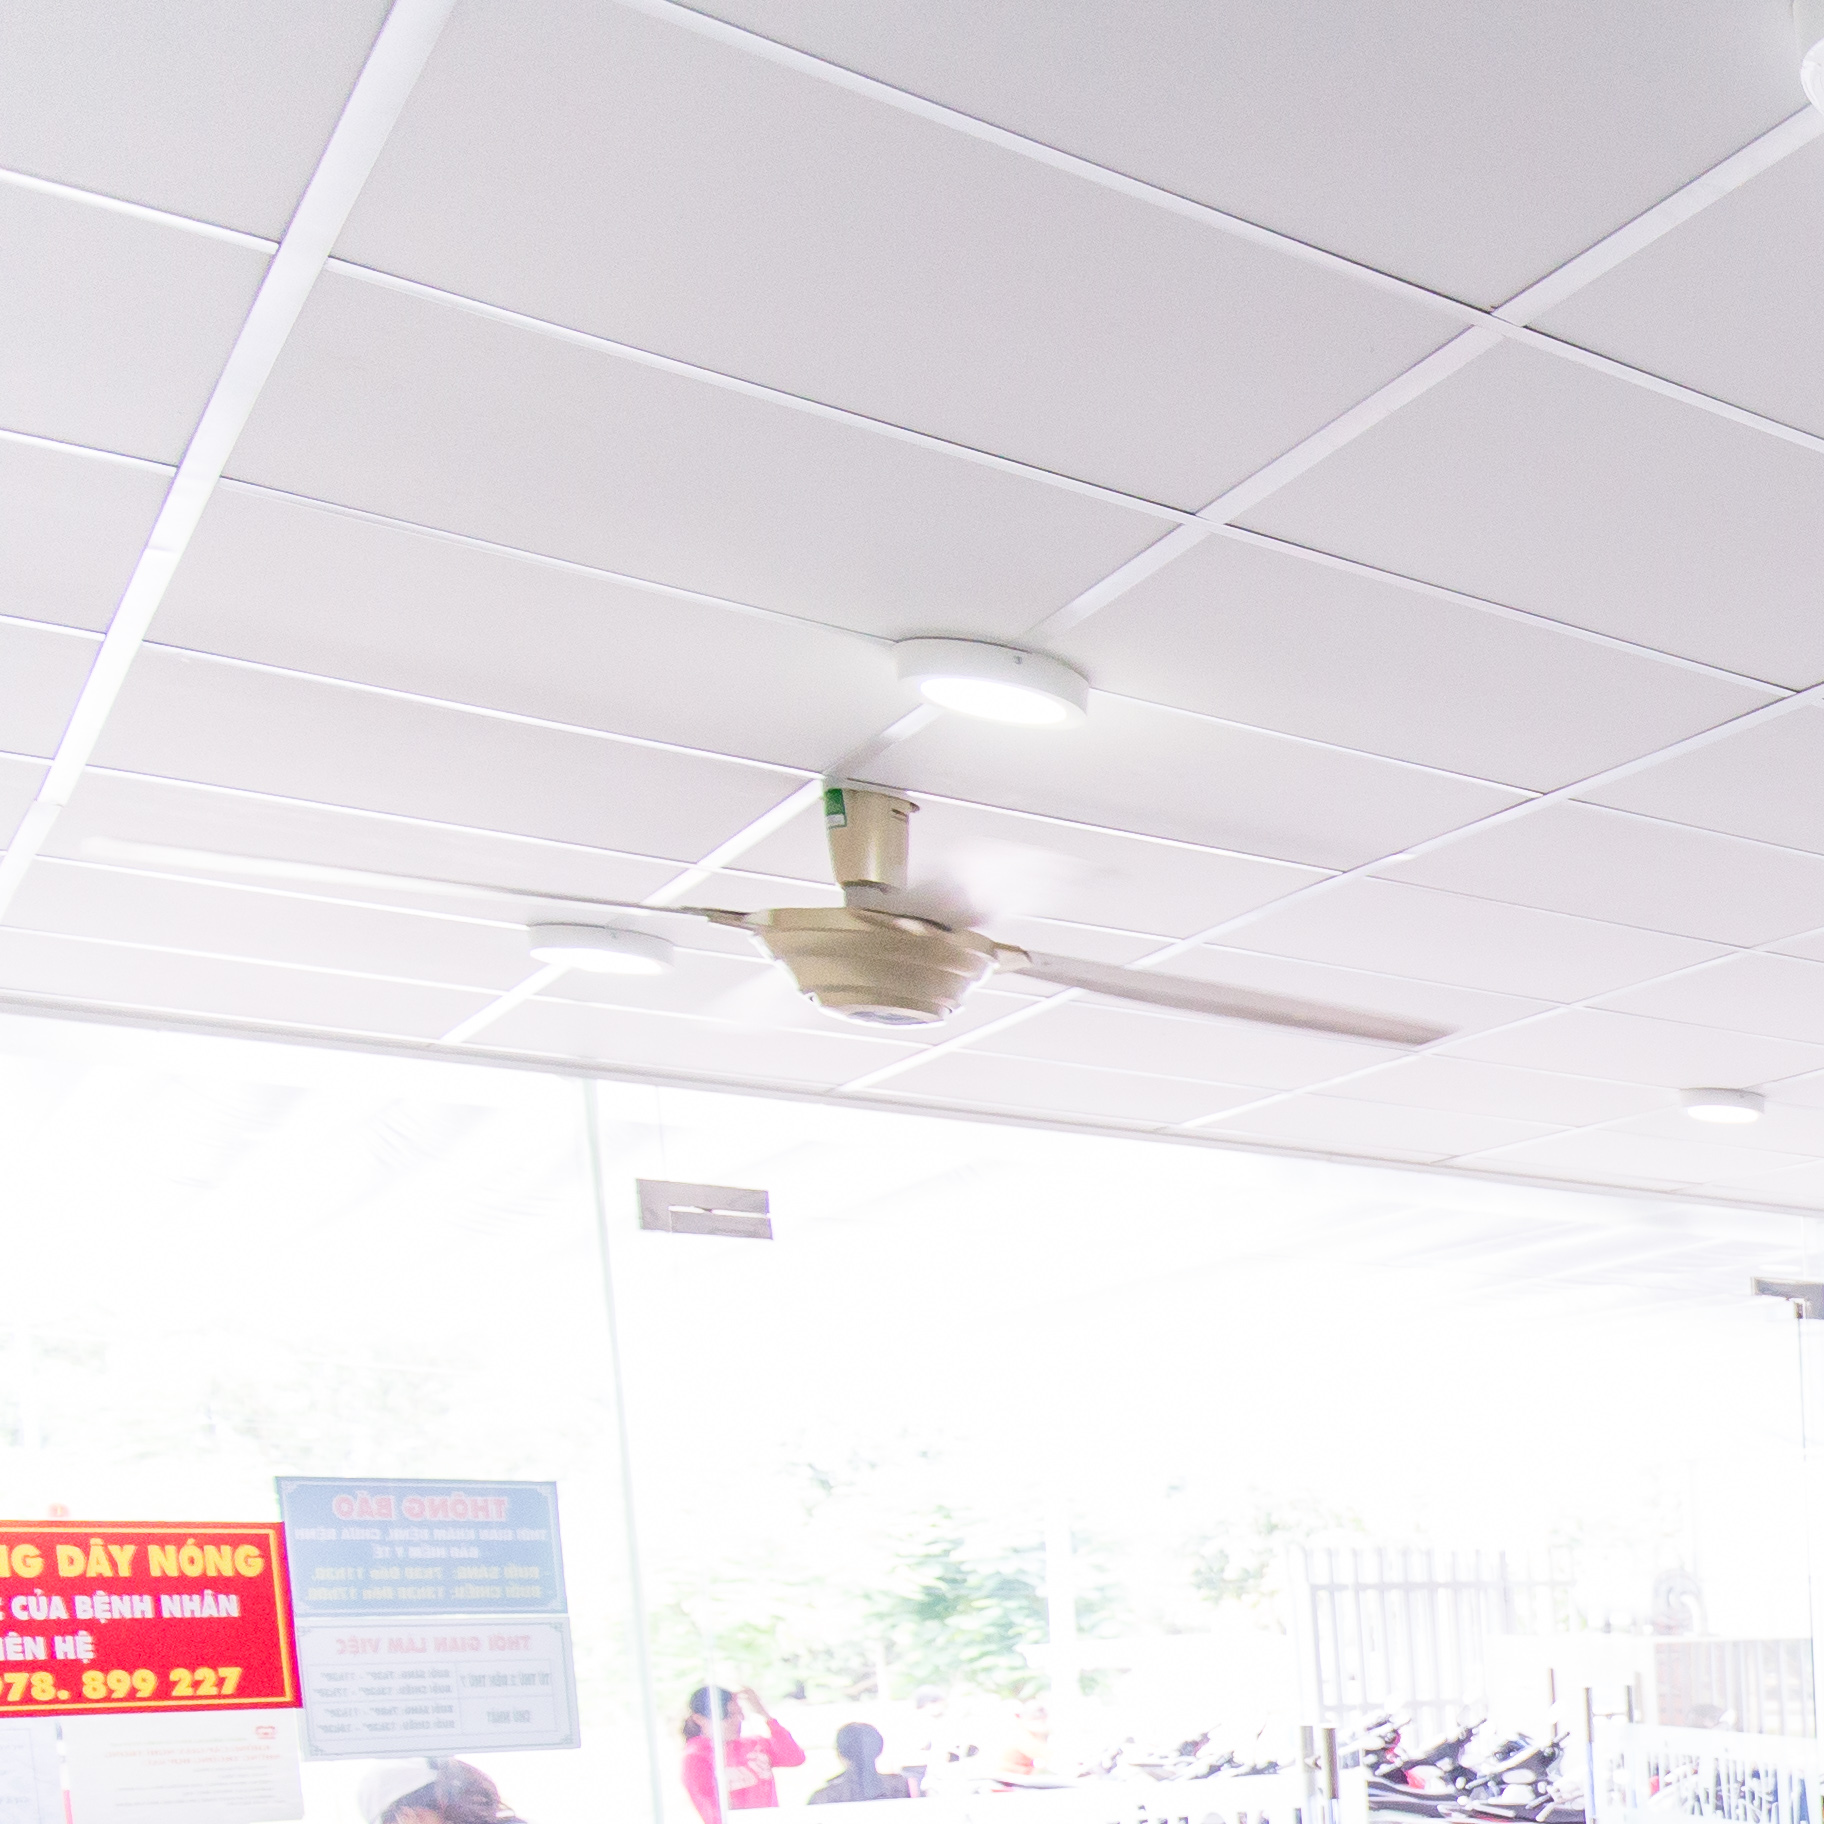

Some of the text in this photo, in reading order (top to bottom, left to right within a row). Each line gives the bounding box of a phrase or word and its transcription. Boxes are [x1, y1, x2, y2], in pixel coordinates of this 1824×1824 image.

[56, 1538, 136, 1577] DÂY
[148, 1538, 264, 1577] NÓNG
[10, 1588, 240, 1624] CỦA BỆNH NHÂN
[53, 1630, 95, 1664] HỆ
[81, 1669, 158, 1700] 899
[169, 1667, 242, 1696] 227
